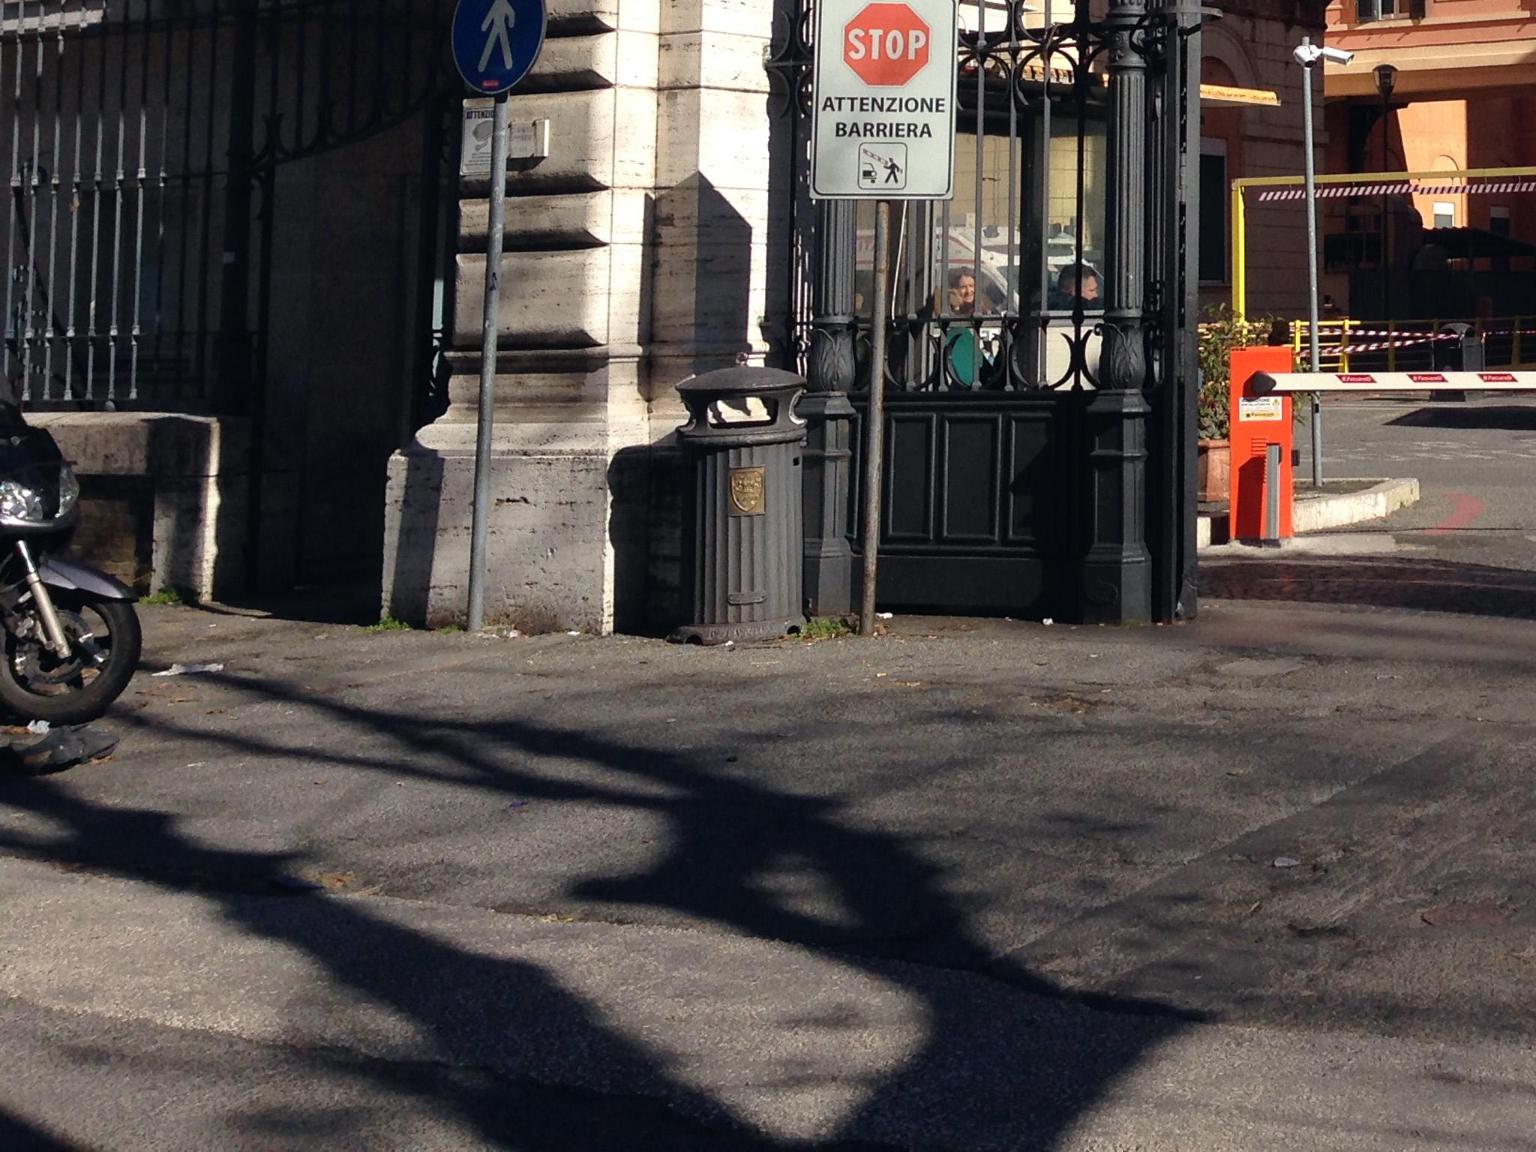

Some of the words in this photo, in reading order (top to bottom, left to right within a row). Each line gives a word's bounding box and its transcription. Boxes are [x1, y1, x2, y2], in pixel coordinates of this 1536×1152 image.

[848, 28, 927, 61] STOP
[821, 96, 946, 113] ATTENZIONE
[834, 121, 933, 138] BARRIERA
